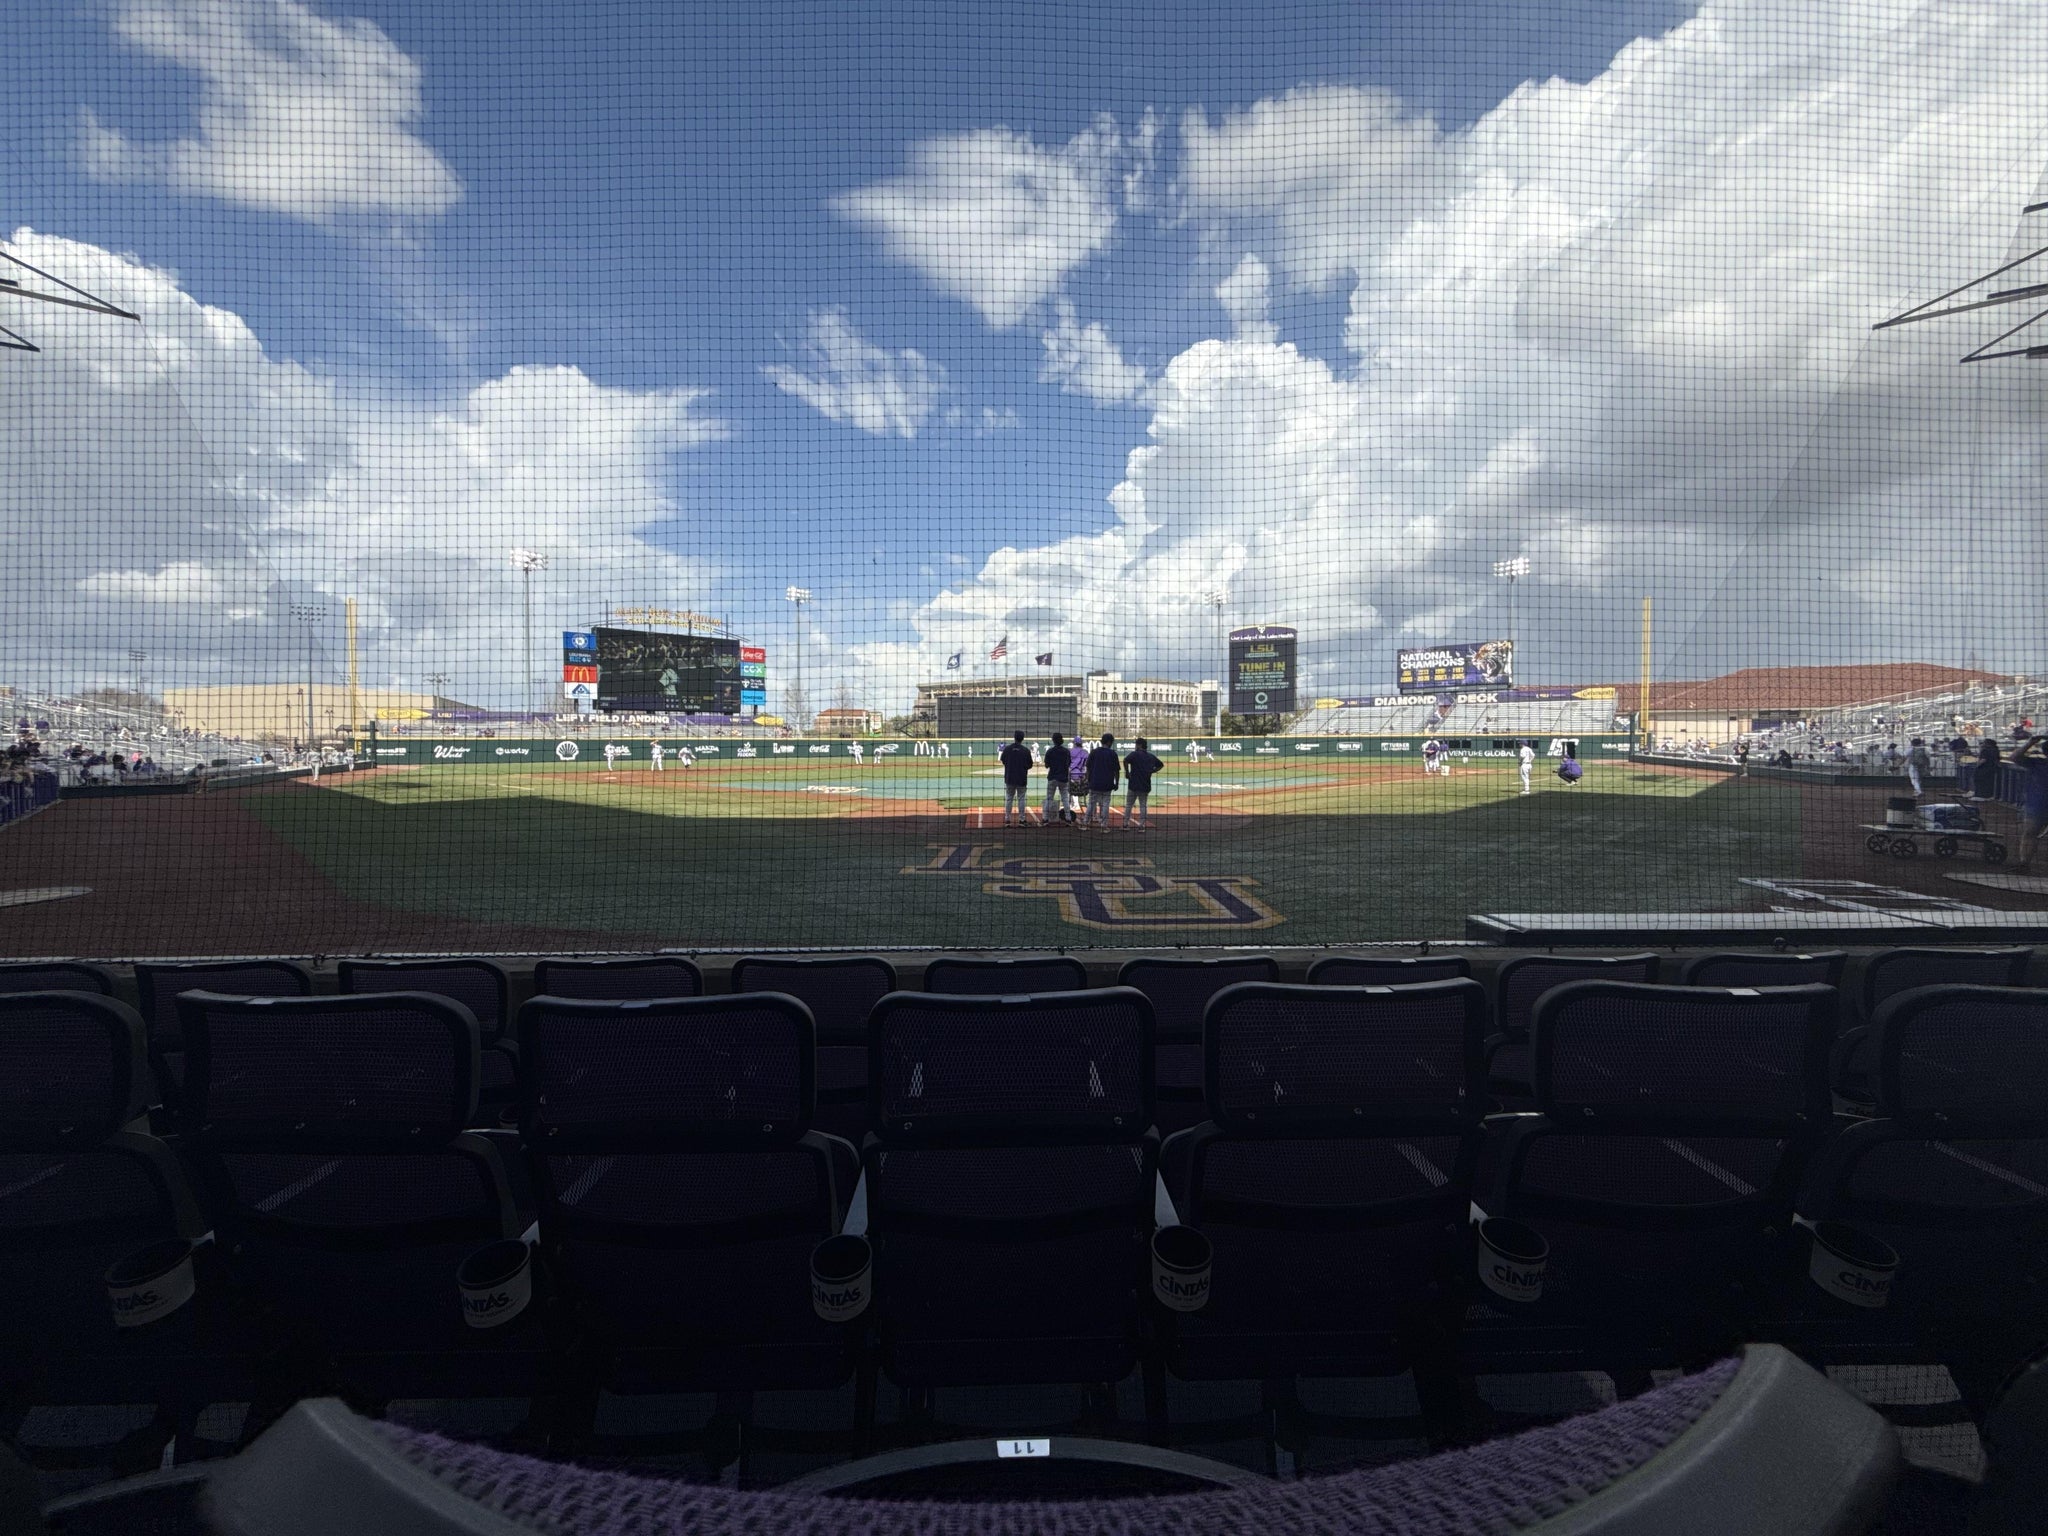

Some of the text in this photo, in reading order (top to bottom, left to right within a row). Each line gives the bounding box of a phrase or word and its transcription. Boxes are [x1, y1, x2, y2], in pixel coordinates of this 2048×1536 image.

[1250, 644, 1274, 653] LSU
[1400, 651, 1453, 662] NATIONAL
[1239, 661, 1286, 672] TUNE IN
[1400, 657, 1465, 669] CHAMPIONS
[1374, 693, 1498, 706] DIAMOND DECK
[555, 713, 670, 724] LEFT FIELD LANDING
[900, 843, 1288, 931] LSU
